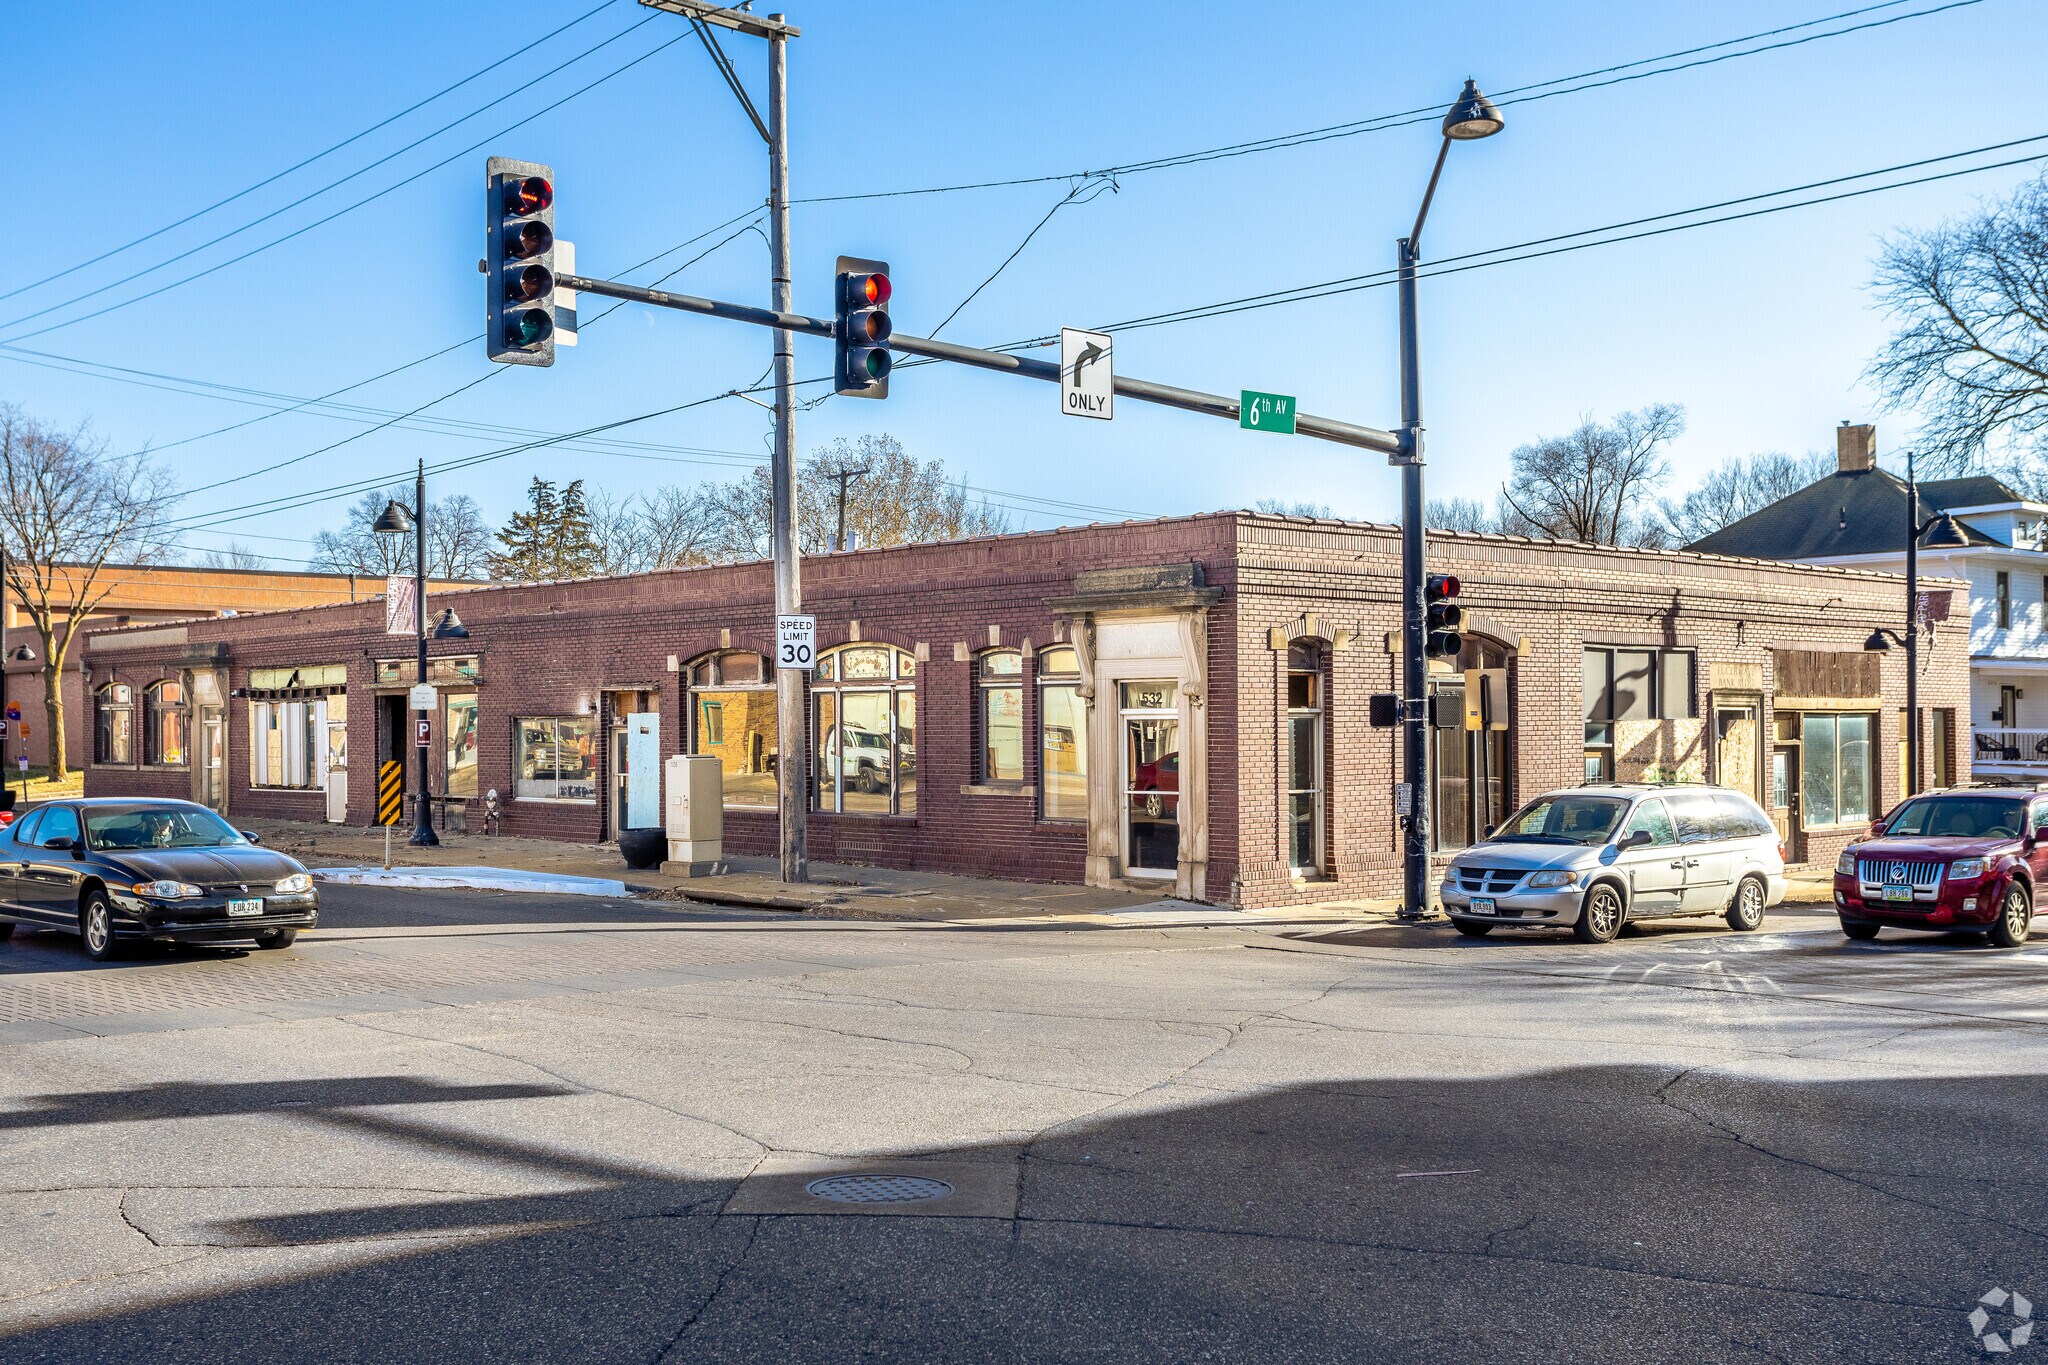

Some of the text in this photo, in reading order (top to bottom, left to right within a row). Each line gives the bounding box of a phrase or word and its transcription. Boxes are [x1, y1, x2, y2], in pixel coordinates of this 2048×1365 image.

[1069, 392, 1105, 412] ONLY
[1250, 397, 1287, 425] 6th AV
[780, 621, 813, 630] SPEED
[783, 632, 809, 641] LIMIT
[782, 644, 811, 663] 30
[1142, 692, 1162, 705] 532
[419, 723, 429, 737] P
[246, 902, 259, 911] 234
